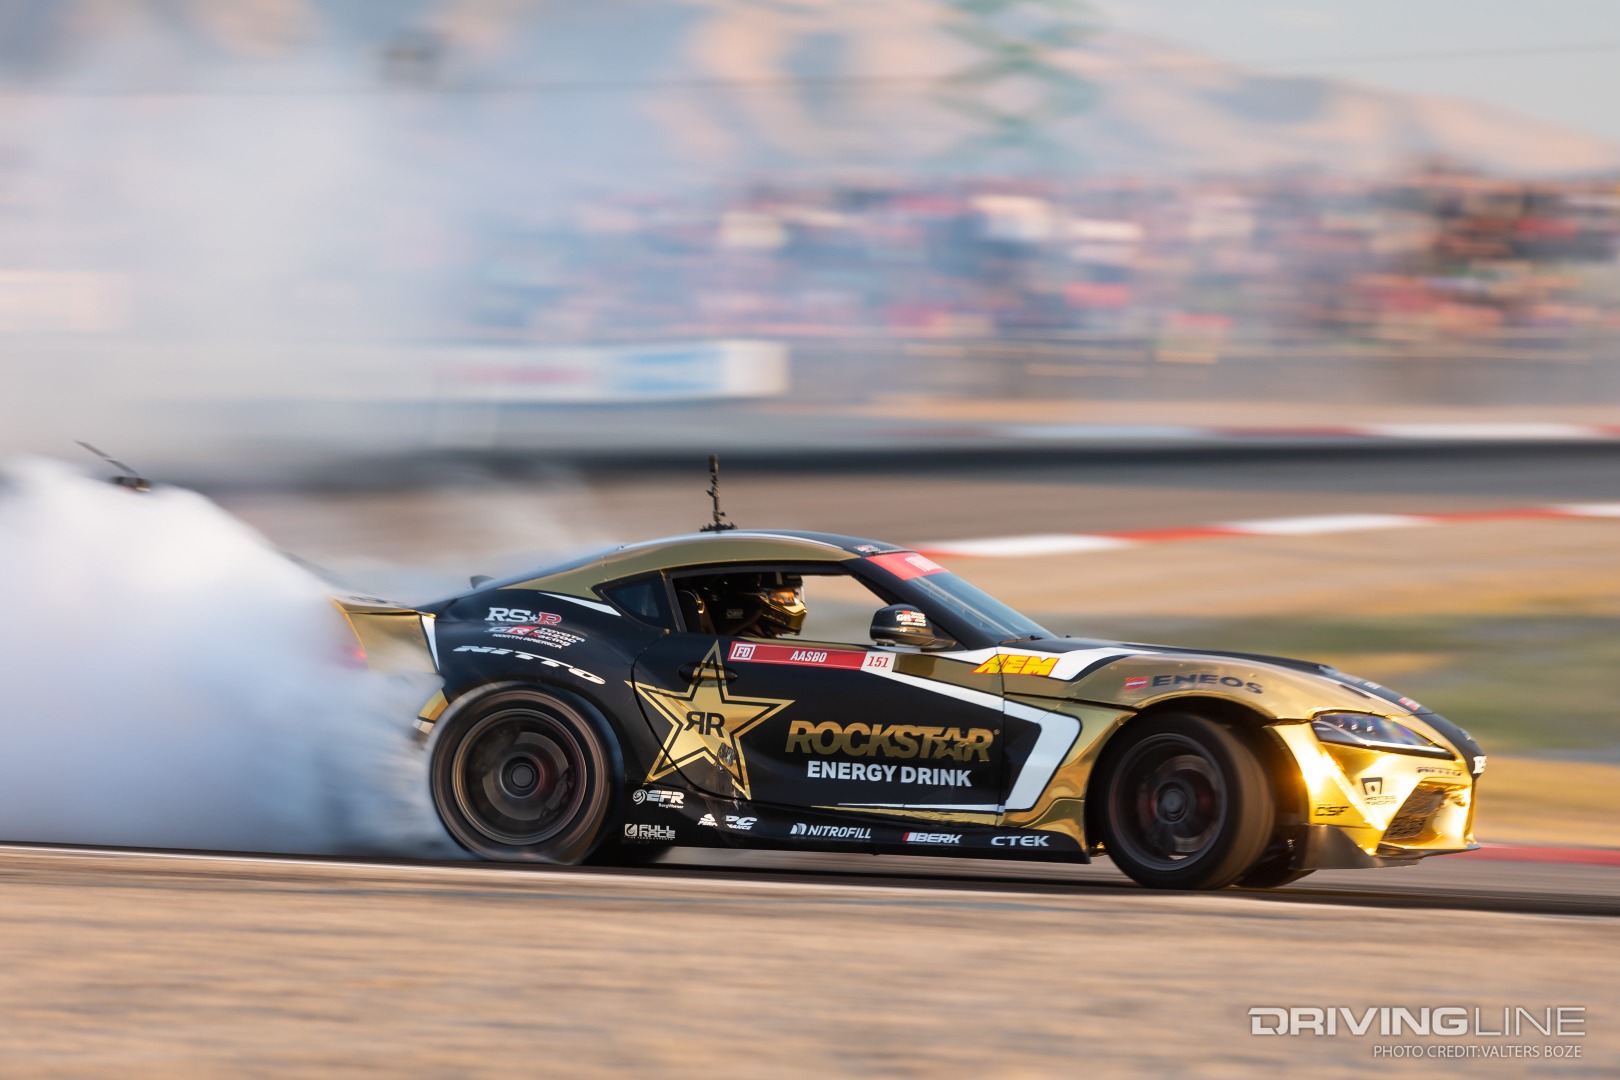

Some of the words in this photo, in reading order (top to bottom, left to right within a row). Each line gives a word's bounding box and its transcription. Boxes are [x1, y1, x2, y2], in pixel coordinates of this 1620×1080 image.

[522, 637, 563, 649] AMERICA
[735, 646, 750, 658] FD
[789, 650, 828, 663] AASBO
[867, 655, 890, 668] 151
[970, 653, 1061, 678] AEM
[1151, 673, 1264, 695] ENEOS
[806, 760, 898, 783] ENERGY
[900, 765, 973, 788] DRINK
[646, 789, 685, 805] EFR
[638, 824, 671, 832] FULL
[638, 829, 676, 839] RACE
[807, 825, 872, 840] NITROFILL
[915, 832, 963, 845] BERK
[990, 834, 1050, 848] CTEK
